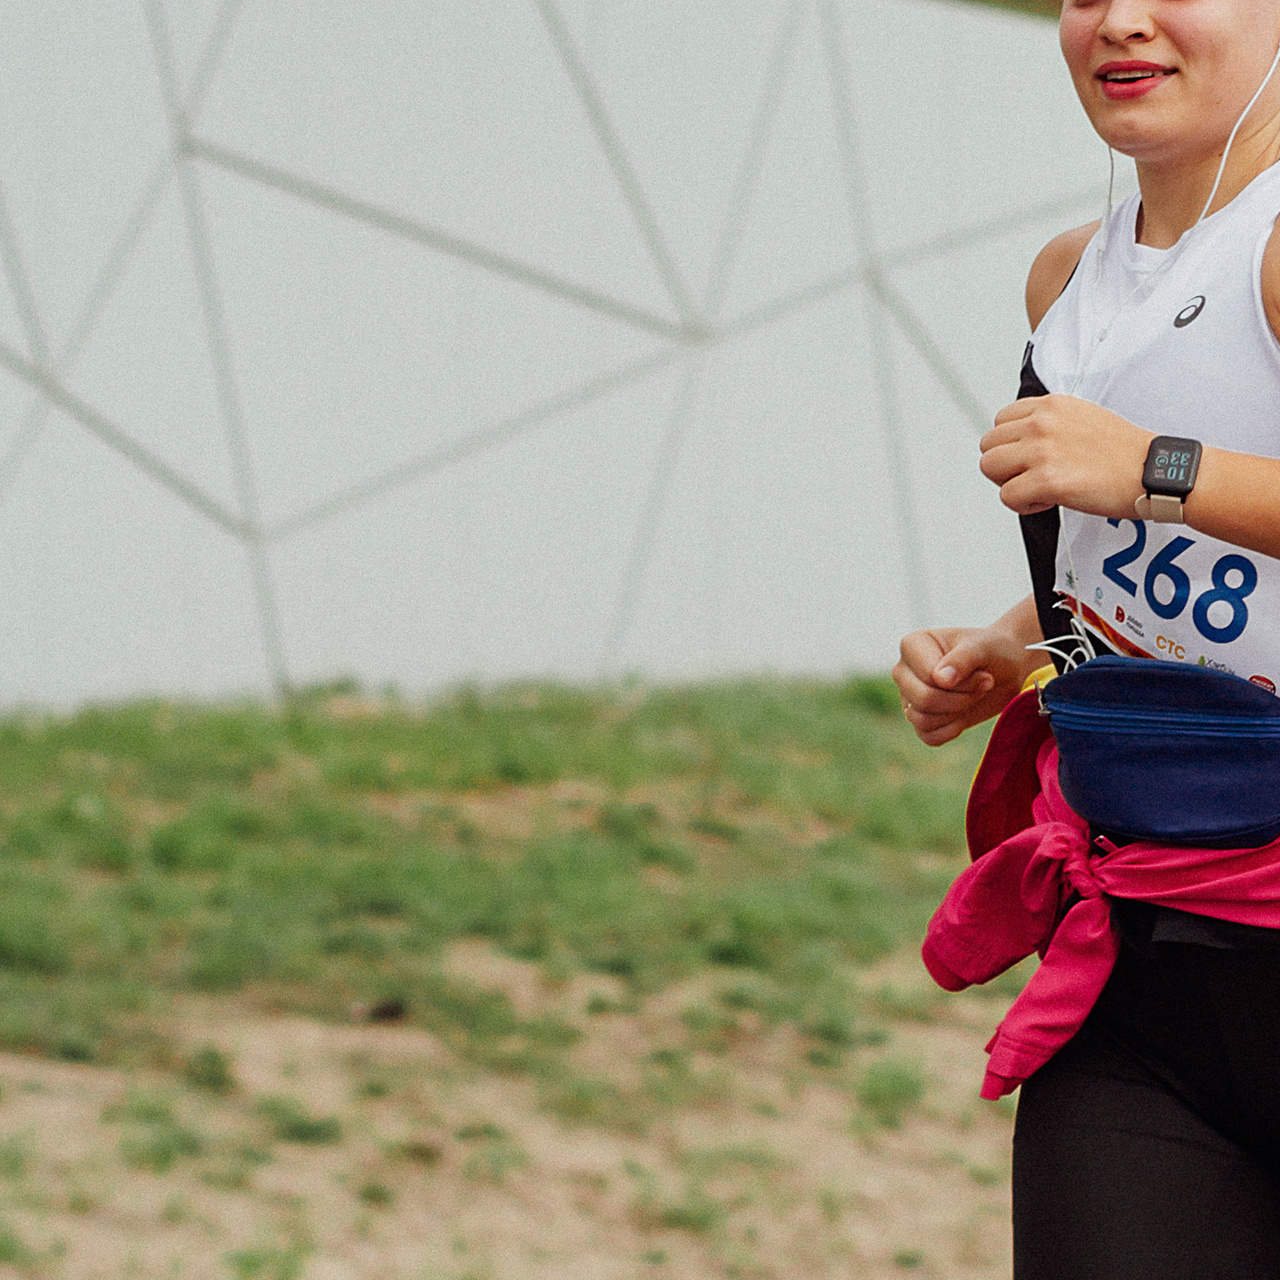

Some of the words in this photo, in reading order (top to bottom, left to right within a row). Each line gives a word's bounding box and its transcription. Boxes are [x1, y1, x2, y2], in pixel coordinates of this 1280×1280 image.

[1170, 450, 1191, 466] 33
[1167, 466, 1185, 481] 10
[1102, 518, 1258, 644] 268
